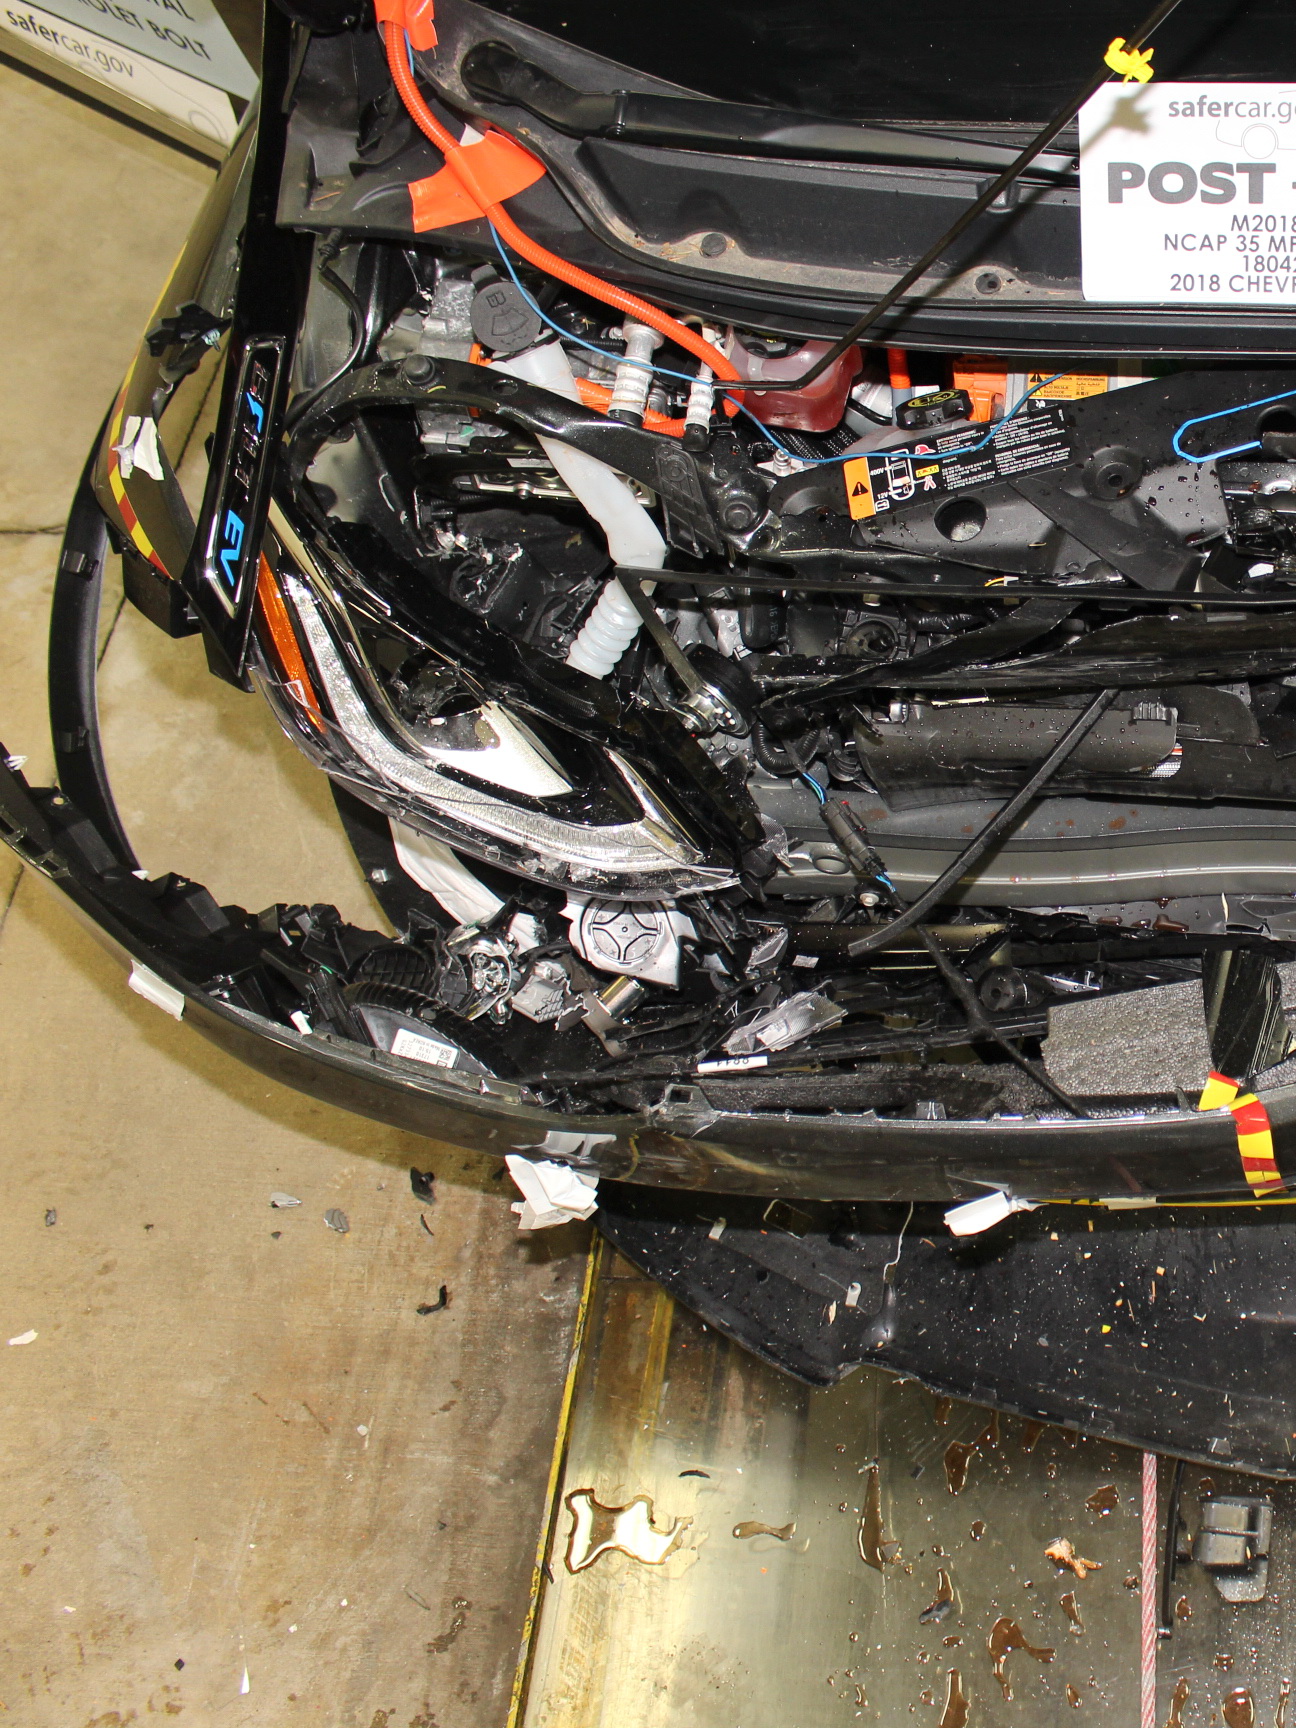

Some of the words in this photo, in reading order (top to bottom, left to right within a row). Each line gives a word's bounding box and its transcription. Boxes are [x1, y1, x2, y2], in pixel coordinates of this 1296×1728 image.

[5, 9, 135, 78] safercar.gov
[144, 18, 212, 61] BOLT
[1107, 161, 1277, 204] POST
[1164, 233, 1228, 252] NCAP
[1235, 234, 1260, 253] 35
[1170, 274, 1221, 292] 2018
[877, 491, 889, 500] 12V
[220, 509, 245, 587] EV
